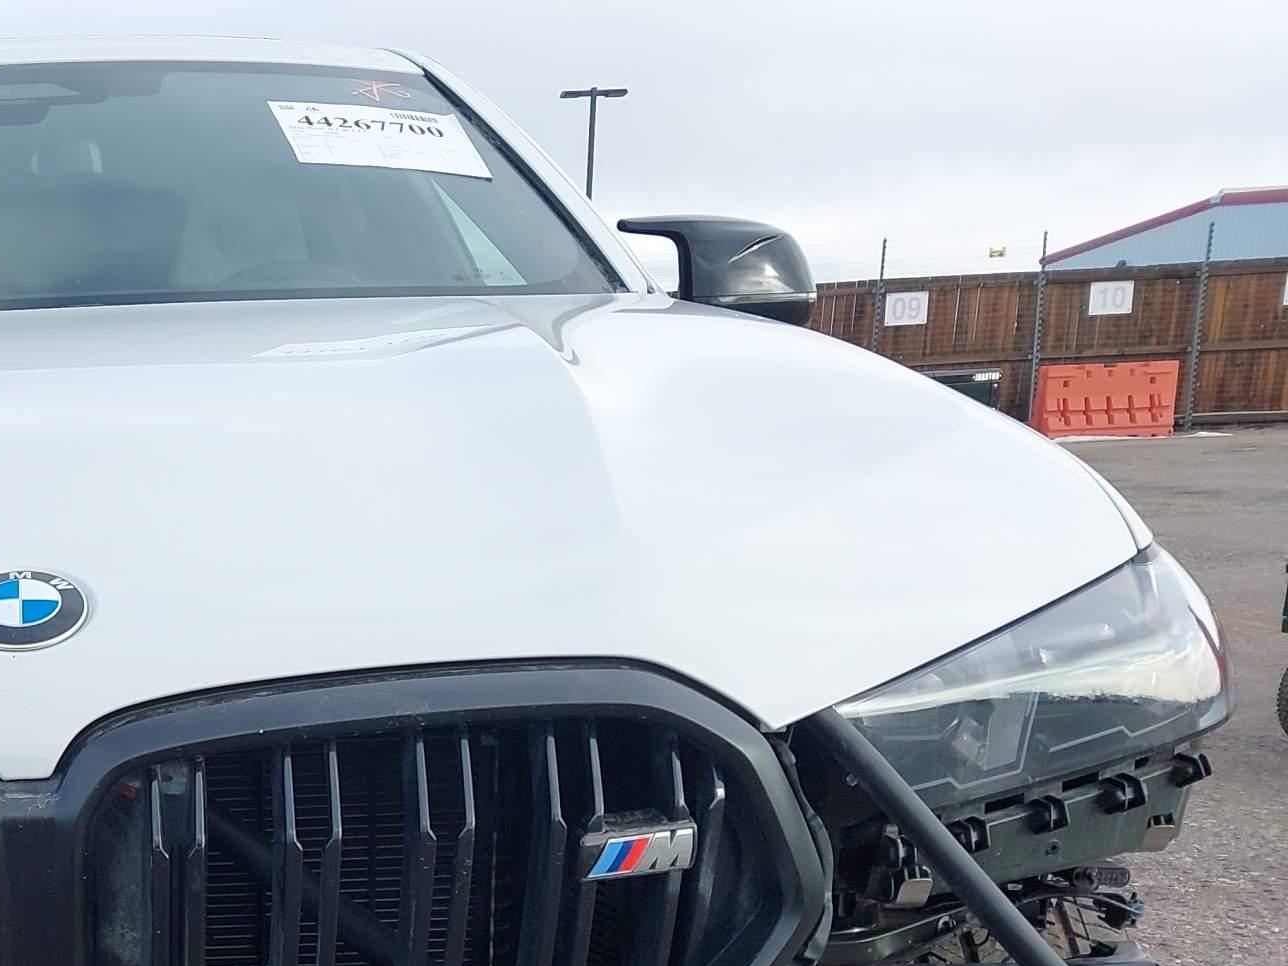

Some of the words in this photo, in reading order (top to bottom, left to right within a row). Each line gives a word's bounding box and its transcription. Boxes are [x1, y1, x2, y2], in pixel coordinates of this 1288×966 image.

[297, 114, 444, 138] 44267700
[891, 296, 922, 321] 09
[1097, 285, 1127, 310] 10
